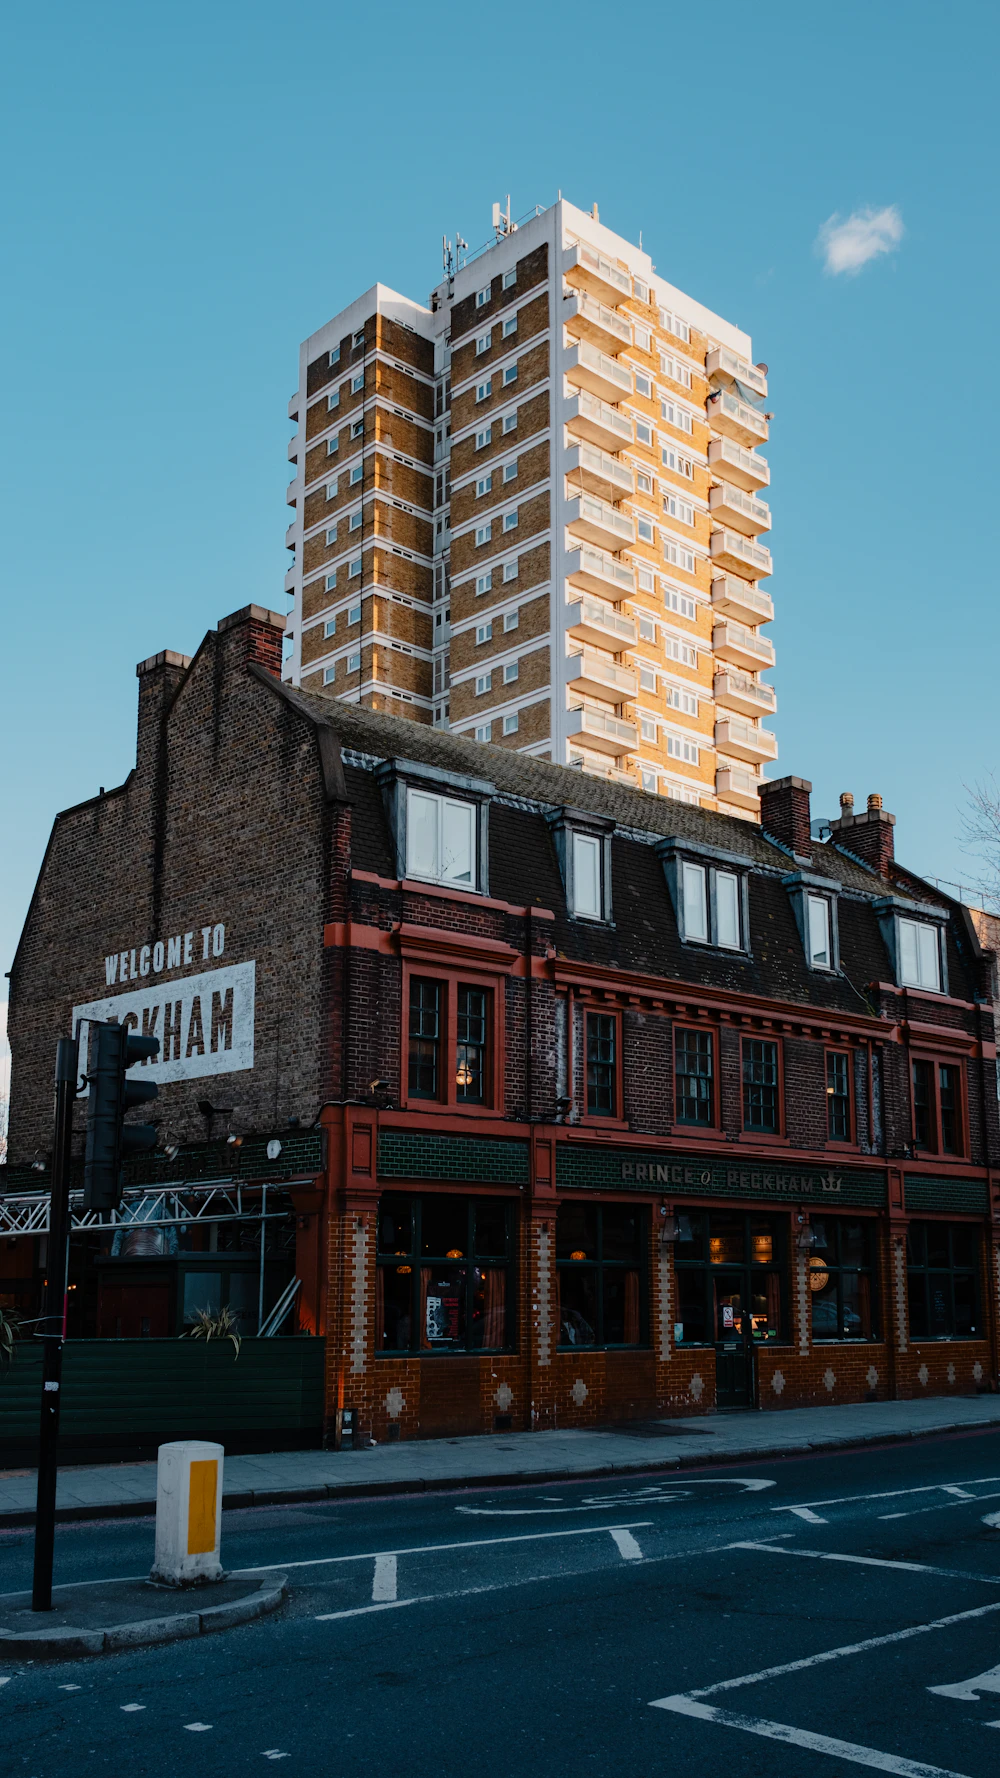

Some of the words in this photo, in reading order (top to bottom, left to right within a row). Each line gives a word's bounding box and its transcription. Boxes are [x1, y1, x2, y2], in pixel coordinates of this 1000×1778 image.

[105, 931, 194, 986] WELCOME
[201, 923, 225, 960] TO
[621, 1161, 694, 1184] PRINCE
[726, 1170, 814, 1193] PECKHAM
